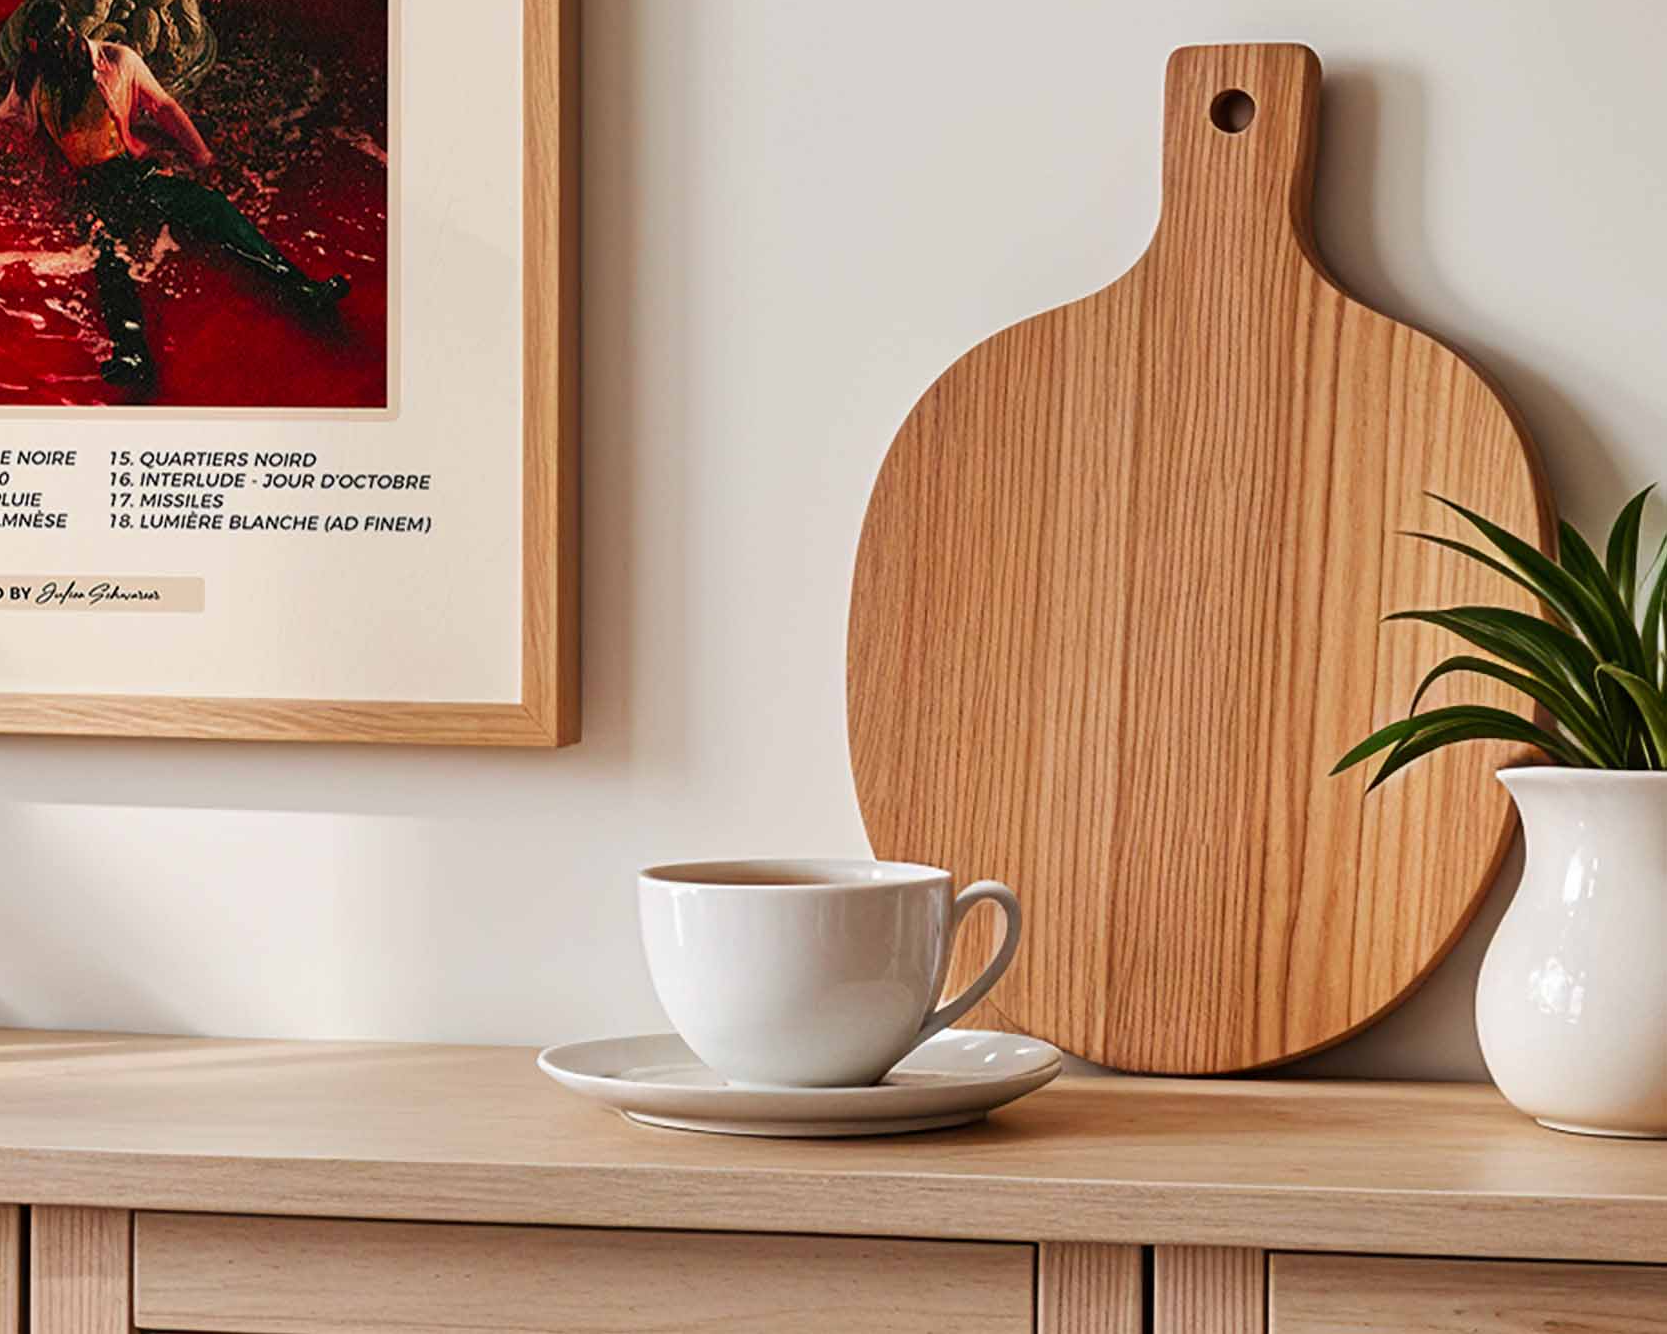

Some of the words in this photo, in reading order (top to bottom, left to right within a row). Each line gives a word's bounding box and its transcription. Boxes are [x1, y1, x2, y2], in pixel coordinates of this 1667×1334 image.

[16, 450, 78, 467] NOIRE
[110, 450, 135, 467] 15.
[138, 450, 250, 470] QUARTIERS
[253, 452, 318, 469] NOIRD
[110, 471, 135, 488] 16.
[139, 471, 247, 489] INTERLUDE
[261, 472, 316, 490] JOUR
[110, 492, 134, 509] 17.
[139, 492, 225, 508] MISSILES
[110, 512, 134, 530] 18.
[139, 510, 225, 531] LUMIÈRE
[228, 513, 320, 532] BLANCHE
[323, 515, 360, 534] (AD
[363, 515, 432, 535] FINEM)
[9, 585, 32, 601] BY
